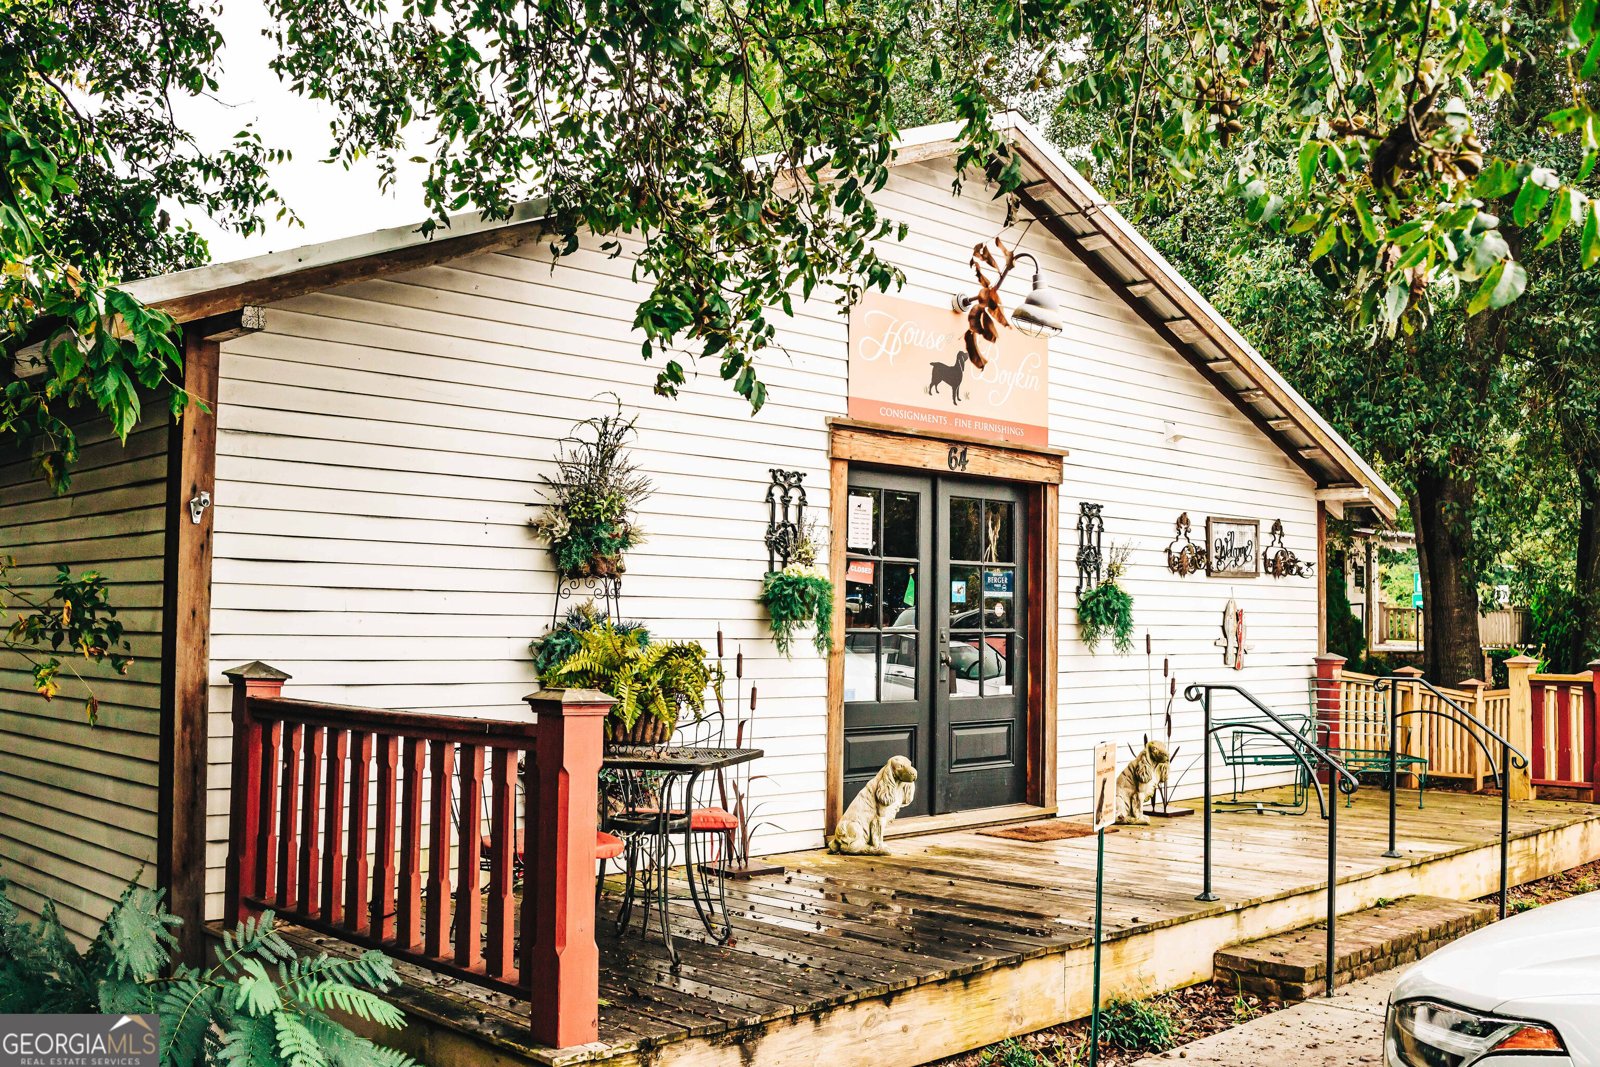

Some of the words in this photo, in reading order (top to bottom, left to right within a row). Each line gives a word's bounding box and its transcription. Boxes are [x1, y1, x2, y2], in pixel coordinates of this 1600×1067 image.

[858, 309, 946, 367] House
[971, 337, 1041, 406] Boykin
[879, 406, 948, 425] CONSIGNMENTS
[954, 417, 973, 429] FINE
[974, 420, 1025, 437] FURNISHINGS
[947, 446, 969, 472] 64
[1214, 531, 1253, 571] Welcome
[850, 565, 873, 575] CLOSED
[987, 576, 1009, 584] BERGER
